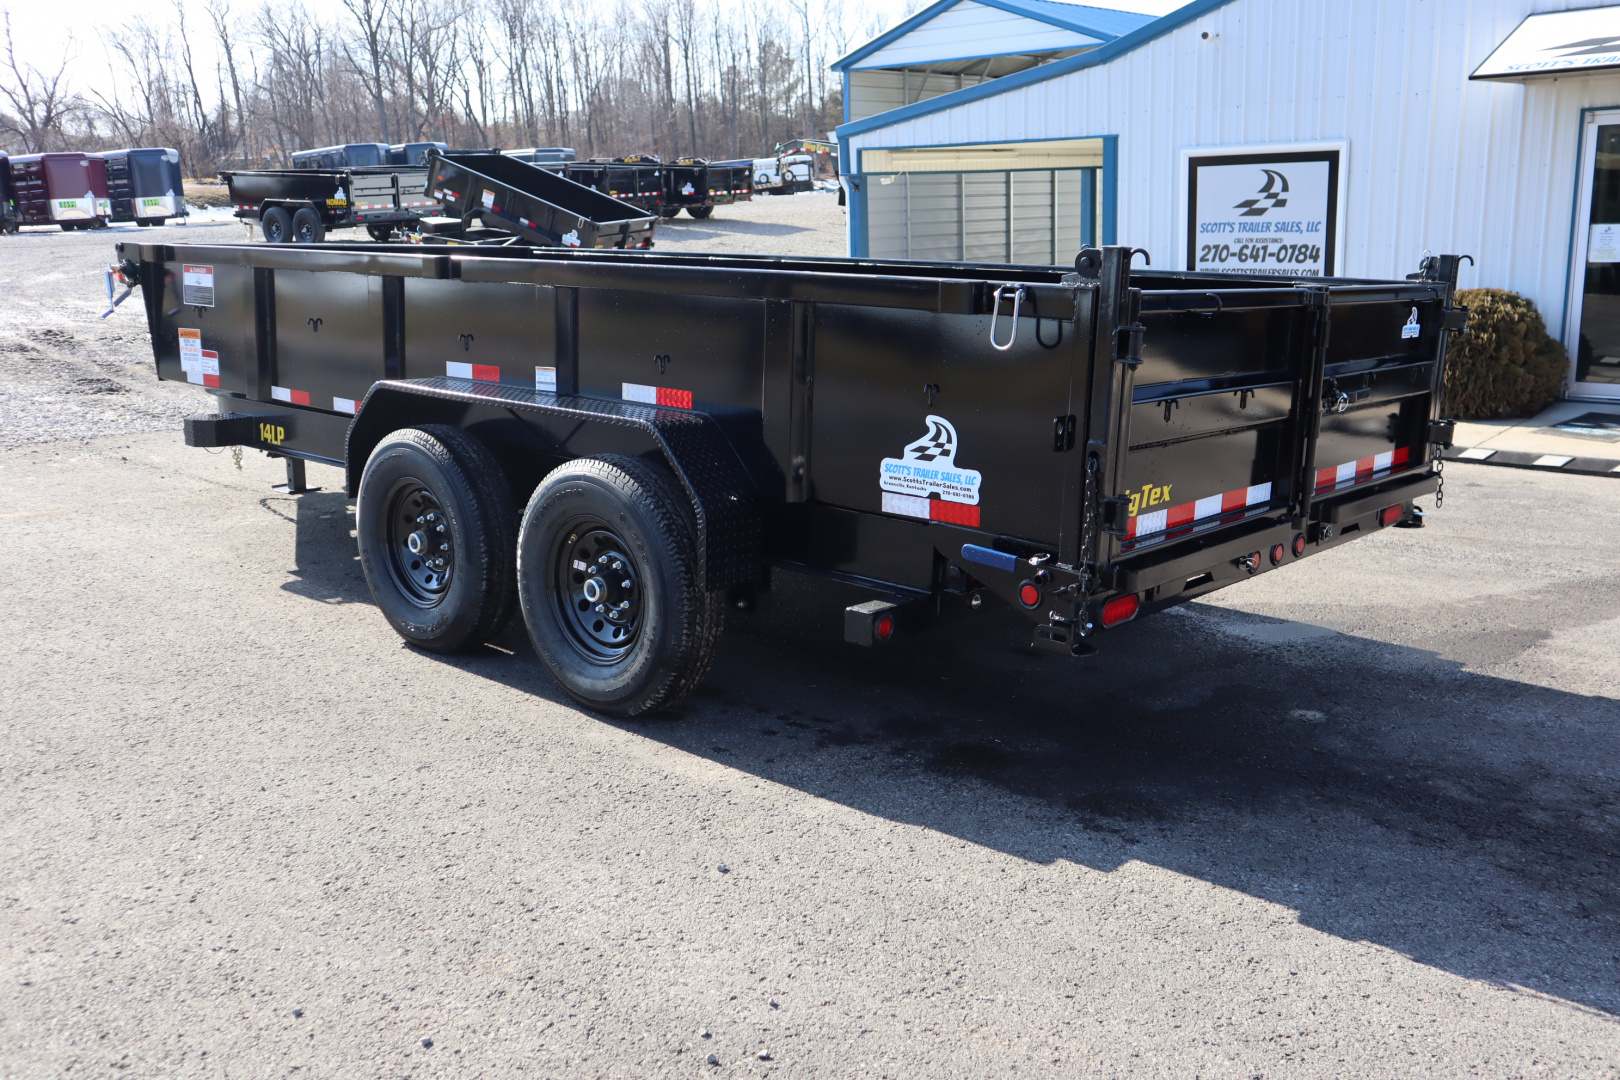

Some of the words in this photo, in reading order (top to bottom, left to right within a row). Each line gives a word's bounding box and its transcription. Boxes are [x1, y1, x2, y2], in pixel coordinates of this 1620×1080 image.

[1503, 58, 1579, 72] SCOTT'S
[802, 142, 830, 153] BigTex
[325, 198, 348, 206] NOMAD
[1199, 221, 1236, 234] SCOTT'S
[1238, 221, 1272, 233] TRAILER
[1274, 221, 1304, 234] SALES,
[1306, 221, 1322, 233] LLC
[1199, 243, 1321, 264] 270-641-0784
[1200, 268, 1319, 277] WWWSCOTTSTRAILERSALESCOM
[259, 422, 285, 446] 14LP
[884, 463, 912, 476] SCOTT'S
[913, 467, 940, 480] TRAILER
[940, 471, 964, 485] SALES,
[964, 475, 977, 486] LLC
[888, 475, 972, 492] www.ScottsTrailerSales.com
[906, 484, 927, 492] Kentucky
[1125, 484, 1173, 517] gTex
